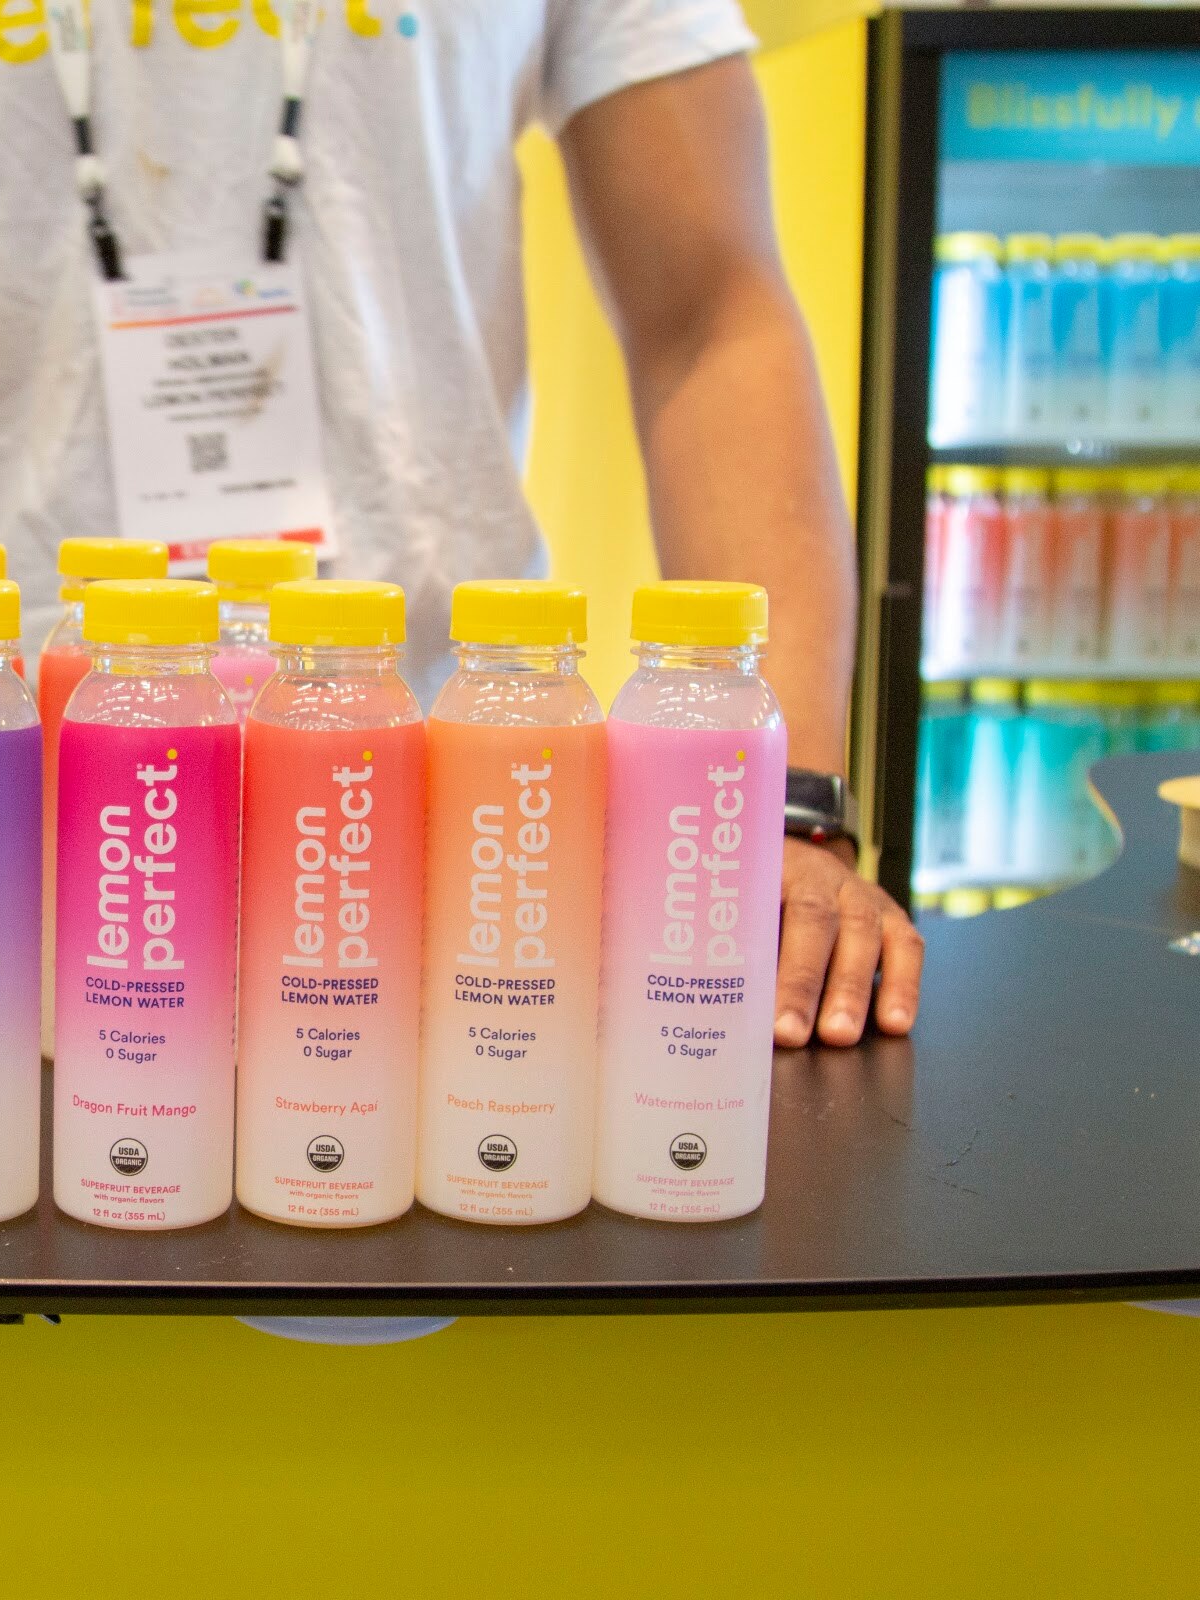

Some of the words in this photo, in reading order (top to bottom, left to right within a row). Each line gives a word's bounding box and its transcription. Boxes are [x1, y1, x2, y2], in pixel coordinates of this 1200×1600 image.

[968, 81, 1181, 141] Blissfully
[87, 805, 130, 969] lemon
[282, 805, 326, 968] lemon
[457, 804, 504, 968] lemon
[649, 804, 700, 968] lemon
[86, 977, 184, 993] COLD-PRESSED
[282, 976, 378, 990] COLD-PRESSED
[456, 975, 555, 990] COLD-PRESSED
[648, 974, 745, 989] COLD-PRESSED
[86, 992, 132, 1008] LEMON
[137, 997, 184, 1008] WATER
[282, 991, 328, 1005] LEMON
[333, 993, 378, 1006] WATER
[455, 990, 502, 1004] LEMON
[508, 994, 555, 1006] WATER
[647, 989, 695, 1004] LEMON
[700, 992, 744, 1004] WATER
[99, 1030, 106, 1041] 5
[110, 1030, 165, 1044] Calories
[296, 1028, 303, 1039] 5
[308, 1028, 360, 1041] Calories
[469, 1027, 476, 1037] 5
[481, 1028, 536, 1041] Calories
[661, 1026, 668, 1037] 5
[673, 1027, 726, 1039] Calories
[106, 1048, 113, 1059] 0
[118, 1049, 157, 1064] Sugar
[304, 1046, 311, 1057] 0
[316, 1047, 352, 1061] Sugar
[475, 1045, 483, 1056] 0
[488, 1046, 527, 1061] Sugar
[668, 1044, 676, 1055] 0
[680, 1045, 717, 1059] Sugar
[73, 1095, 112, 1114] Dragon
[117, 1103, 148, 1116] Fruit
[152, 1104, 196, 1118] Mango
[276, 1097, 346, 1116] Strawberry
[447, 1094, 484, 1111] Peach
[488, 1100, 555, 1115] Raspberry
[635, 1092, 713, 1111] Watermelon
[717, 1098, 744, 1109] Lime
[119, 1147, 139, 1156] USDA
[316, 1144, 336, 1153] USDA
[487, 1143, 508, 1152] USDA
[678, 1142, 698, 1150] USDA
[115, 1158, 142, 1166] ORGANIC
[484, 1154, 511, 1162] ORGANIC
[675, 1152, 701, 1160] ORGANIC
[81, 1178, 130, 1193] SUPERFRUIT
[133, 1185, 180, 1194] BEVERAGE
[275, 1176, 326, 1190] SUPERFRUIT
[329, 1181, 374, 1190] BEVERAGE
[446, 1174, 497, 1188] SUPERFRUIT
[502, 1180, 549, 1189] BEVERAGE
[636, 1174, 687, 1186] SUPERFRUIT
[691, 1177, 735, 1187] BEVERAGE
[94, 1192, 108, 1200] with
[110, 1195, 137, 1204] organic
[139, 1196, 164, 1204] flavors
[93, 1208, 100, 1216] 12
[103, 1209, 109, 1218] fl
[125, 1210, 144, 1221] (355
[148, 1211, 165, 1221] mL)
[288, 1204, 296, 1213] 12
[299, 1205, 304, 1213] fl
[320, 1206, 340, 1216] (355
[342, 1206, 359, 1216] mL)
